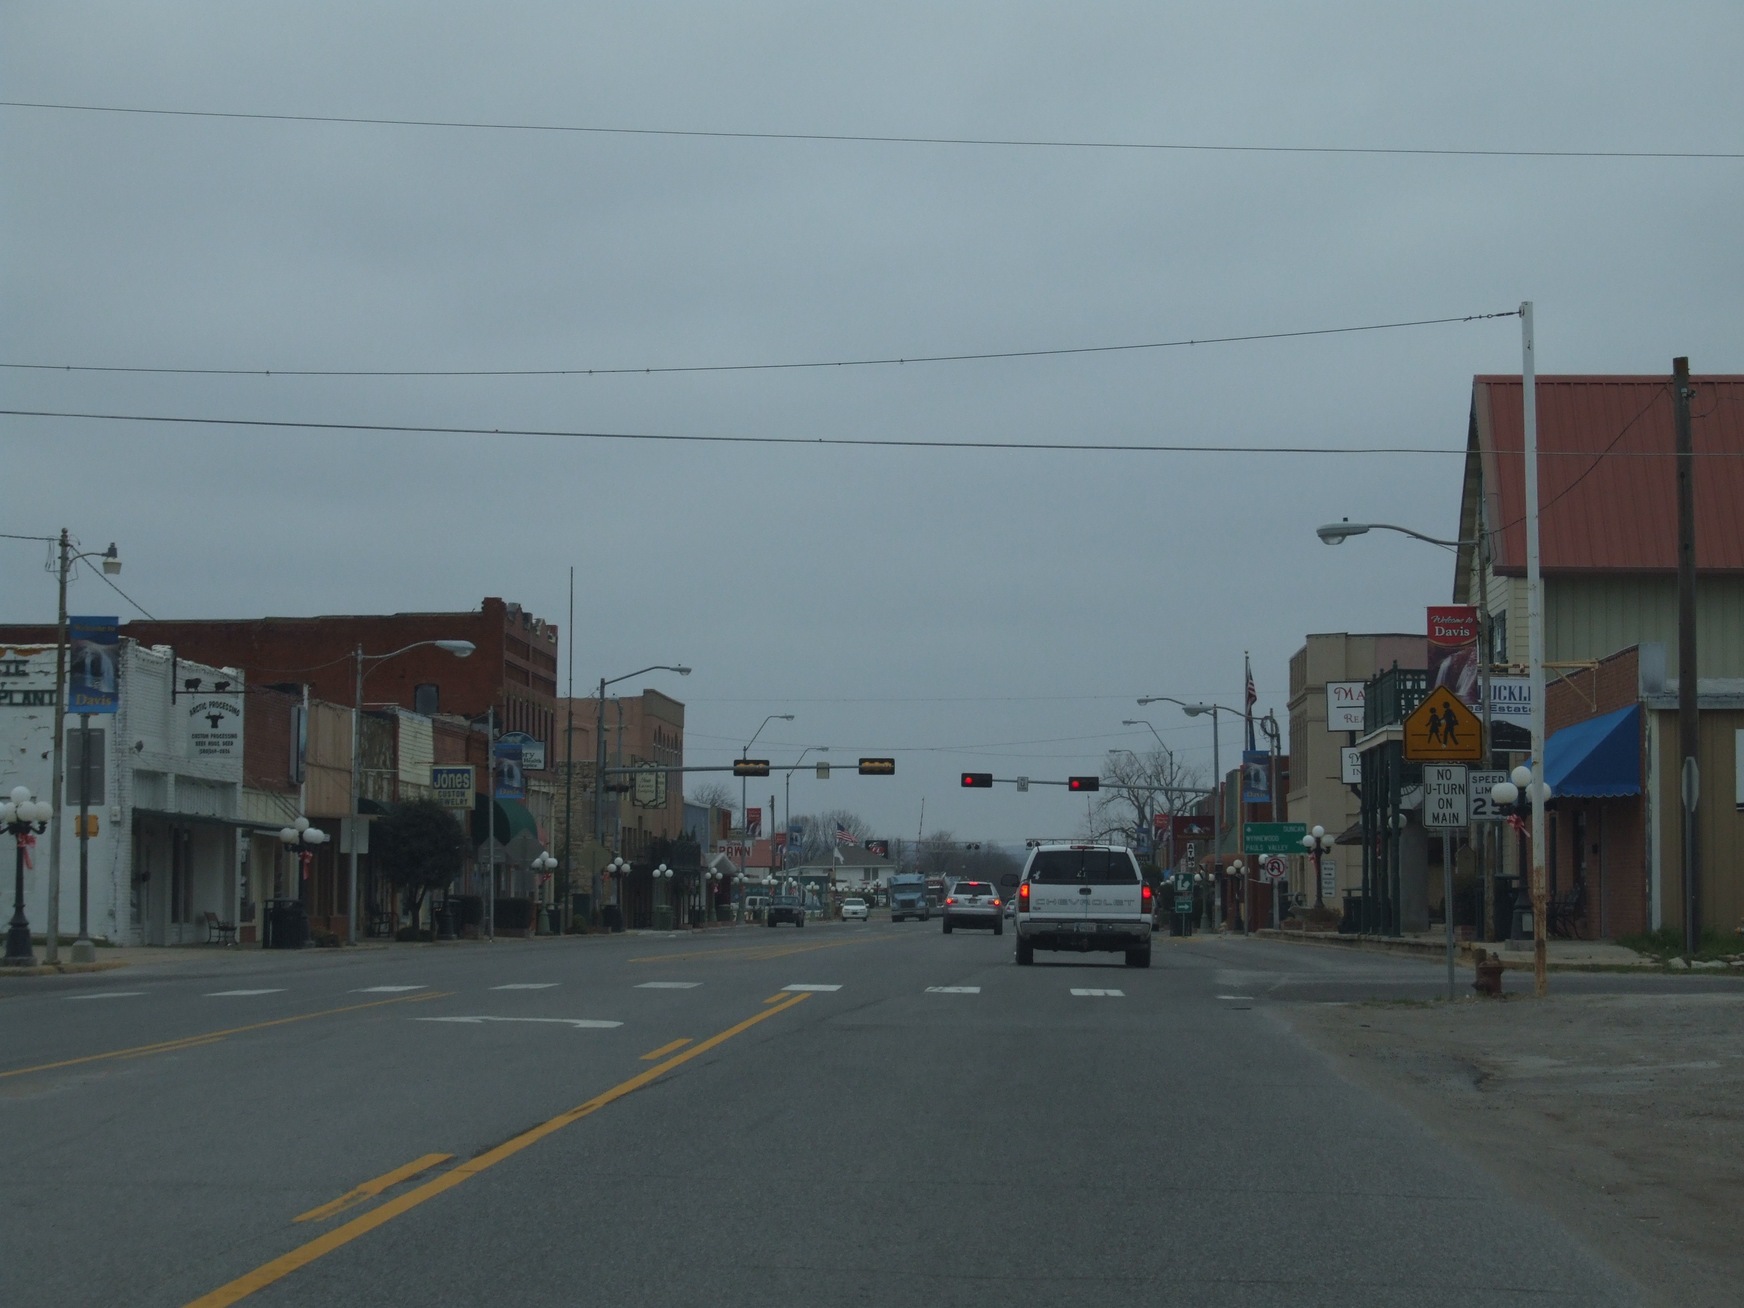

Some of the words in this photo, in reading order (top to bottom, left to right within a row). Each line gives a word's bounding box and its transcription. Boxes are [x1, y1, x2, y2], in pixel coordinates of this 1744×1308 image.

[1431, 615, 1466, 625] Welcome
[1467, 616, 1475, 624] to
[1434, 626, 1470, 638] Davis
[0, 690, 57, 706] PLANT
[76, 693, 112, 705] Davis
[190, 702, 207, 717] ARCTIC
[209, 701, 240, 716] PROCESSING
[434, 771, 470, 788] Jones
[1437, 769, 1452, 781] NO
[1472, 776, 1505, 784] SPEED
[438, 790, 465, 798] CUSTOM
[1426, 783, 1465, 795] U-TURN
[1475, 787, 1491, 795] LIM
[1438, 798, 1452, 810] ON
[1432, 812, 1459, 824] MAIN
[719, 846, 751, 857] PAWN
[1187, 844, 1195, 862] ATM
